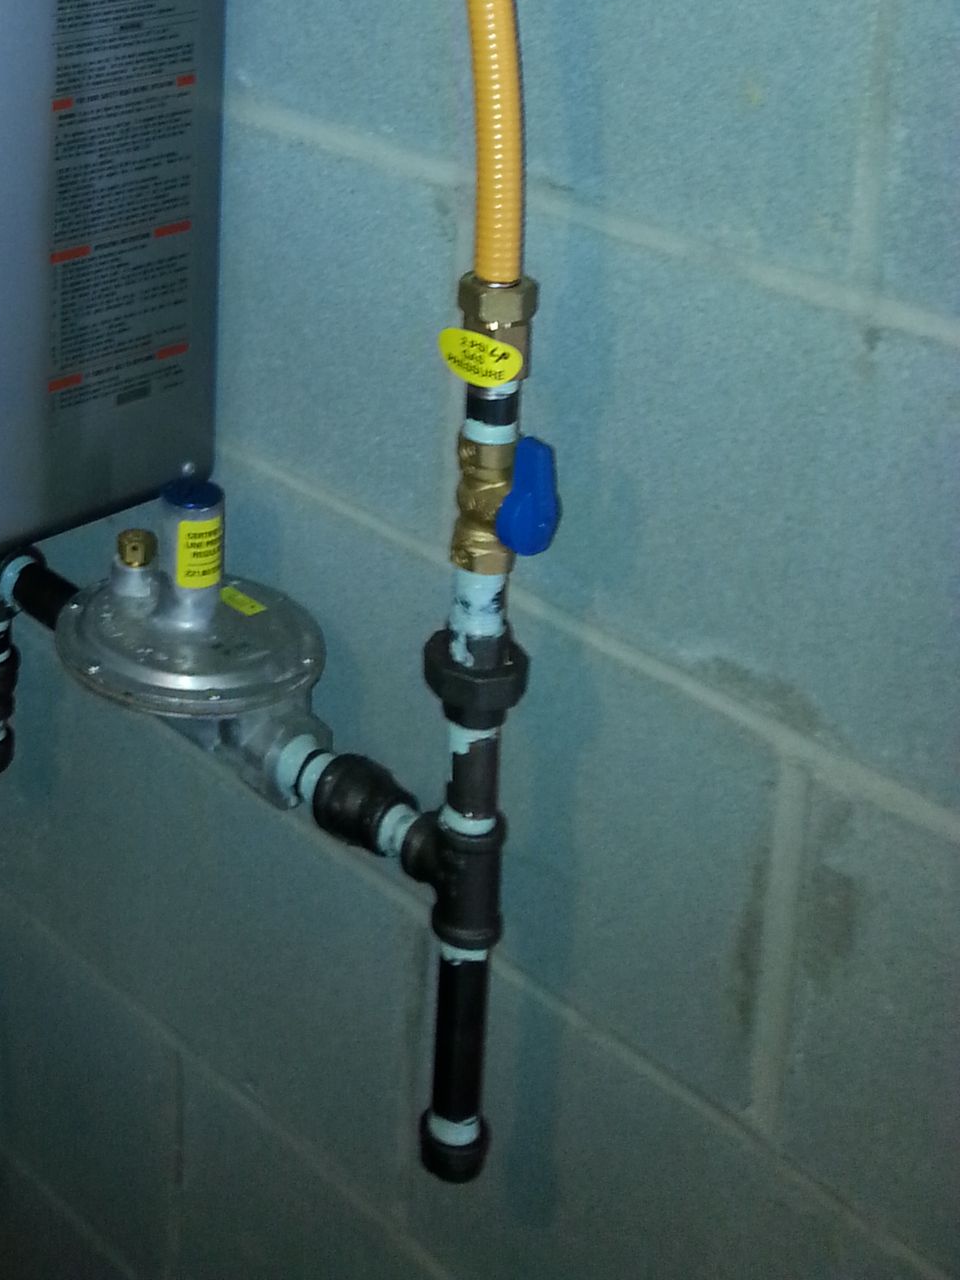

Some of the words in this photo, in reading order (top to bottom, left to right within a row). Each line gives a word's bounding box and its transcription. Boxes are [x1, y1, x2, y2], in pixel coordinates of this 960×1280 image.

[460, 336, 468, 345] 2
[468, 340, 488, 352] PSI
[462, 348, 485, 365] GAS
[448, 352, 504, 380] PRESSURE
